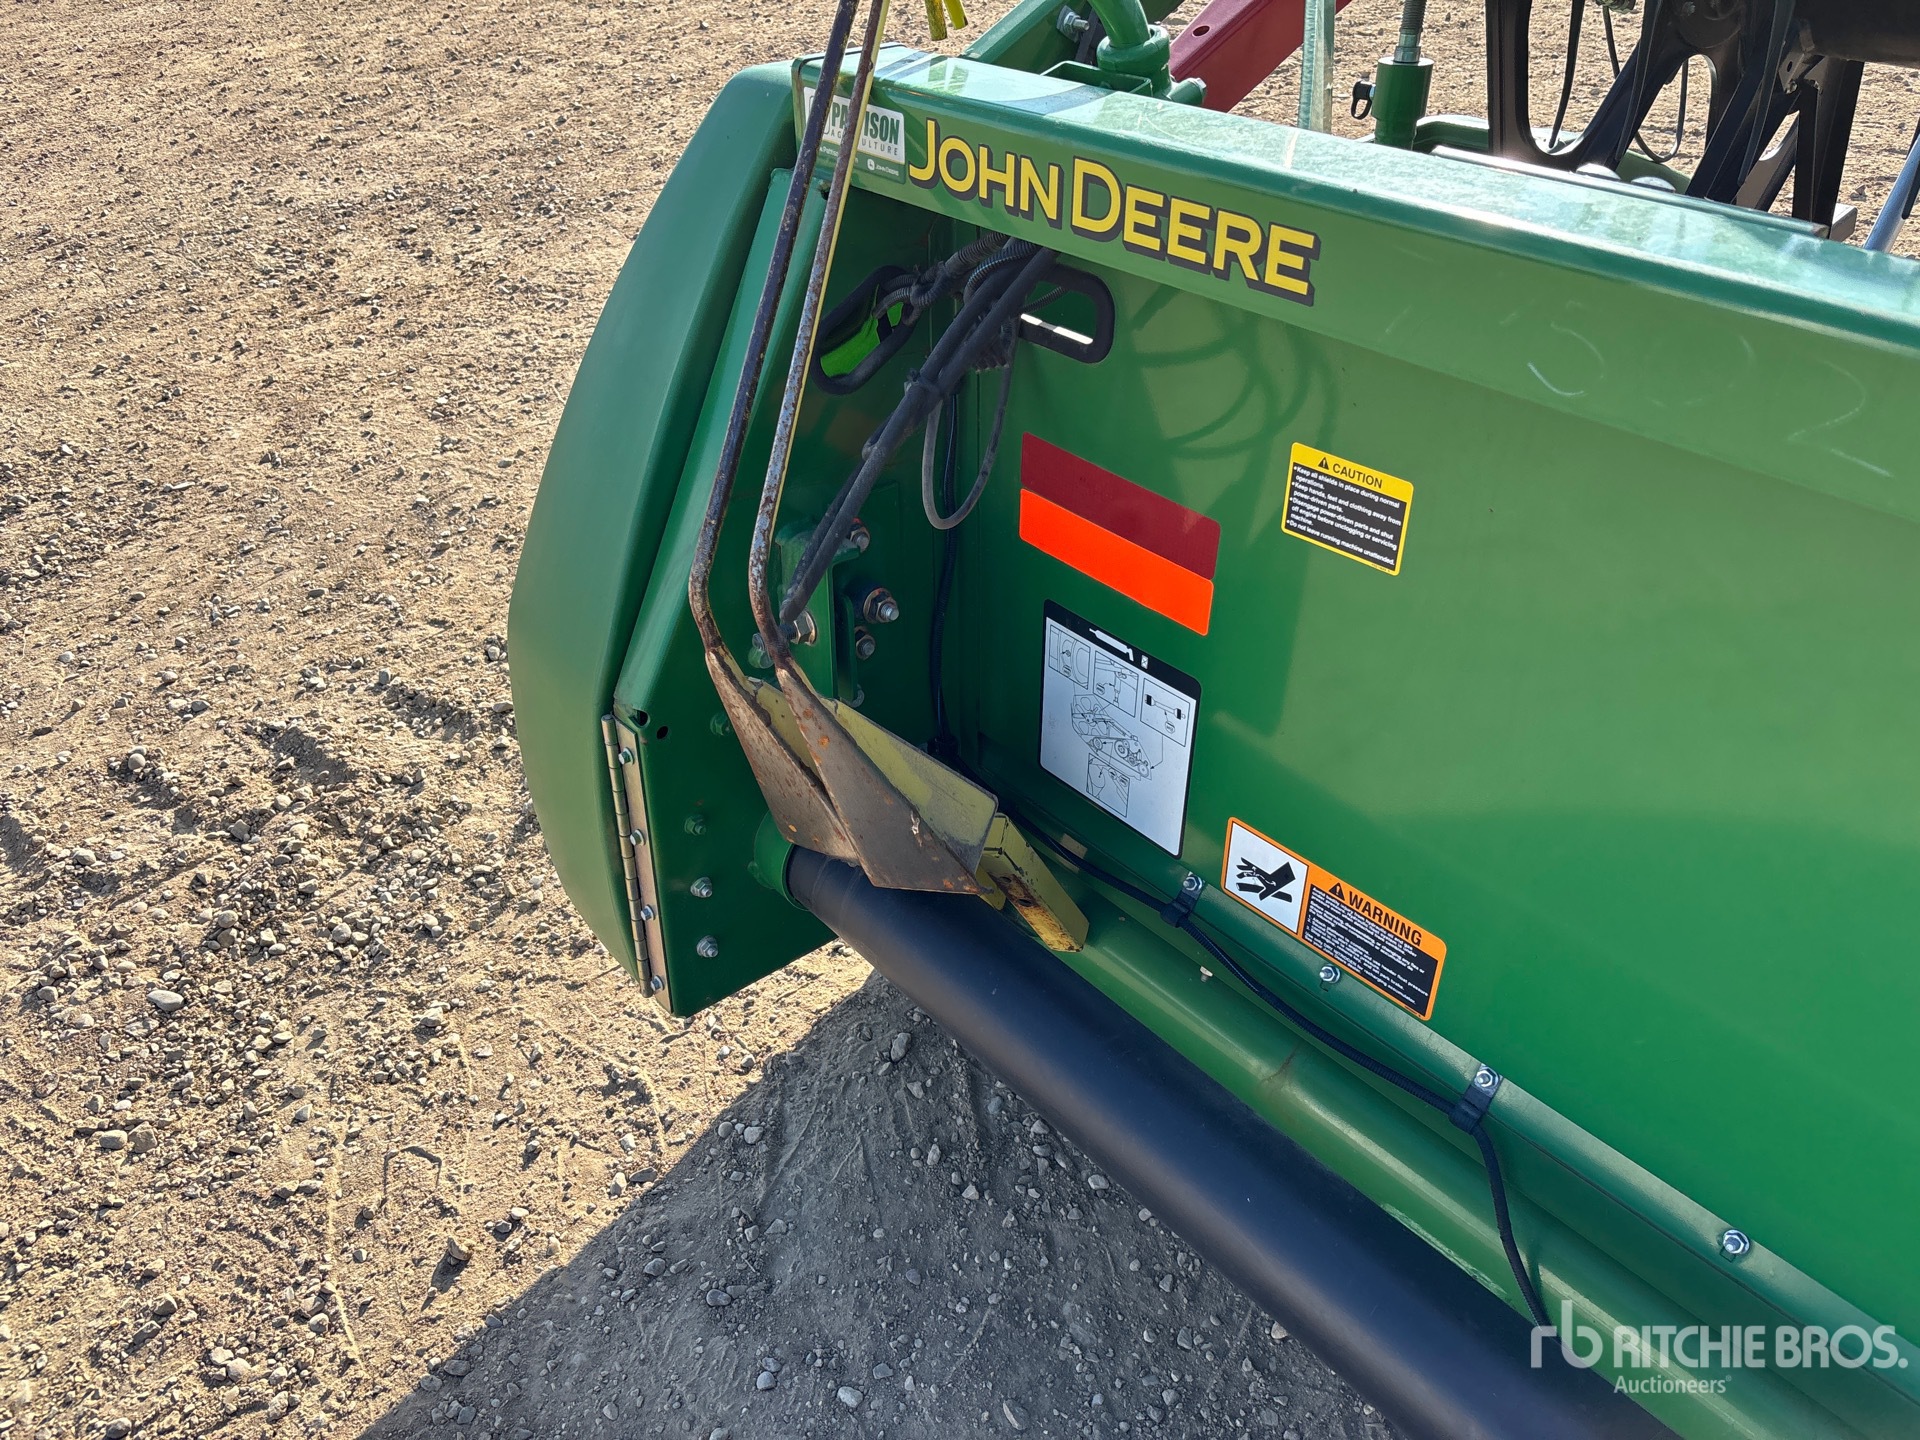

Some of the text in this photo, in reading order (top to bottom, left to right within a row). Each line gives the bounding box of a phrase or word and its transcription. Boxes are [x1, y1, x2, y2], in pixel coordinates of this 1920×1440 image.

[832, 102, 900, 145] PAISON
[831, 129, 898, 156] AGULTURE
[908, 118, 1320, 306] JOHN DEERE
[1332, 463, 1384, 489] CAUTION
[1344, 485, 1360, 494] place
[1360, 490, 1379, 502] during
[1380, 497, 1400, 508] normal
[1388, 516, 1401, 526] from
[1349, 890, 1422, 947] WARNING
